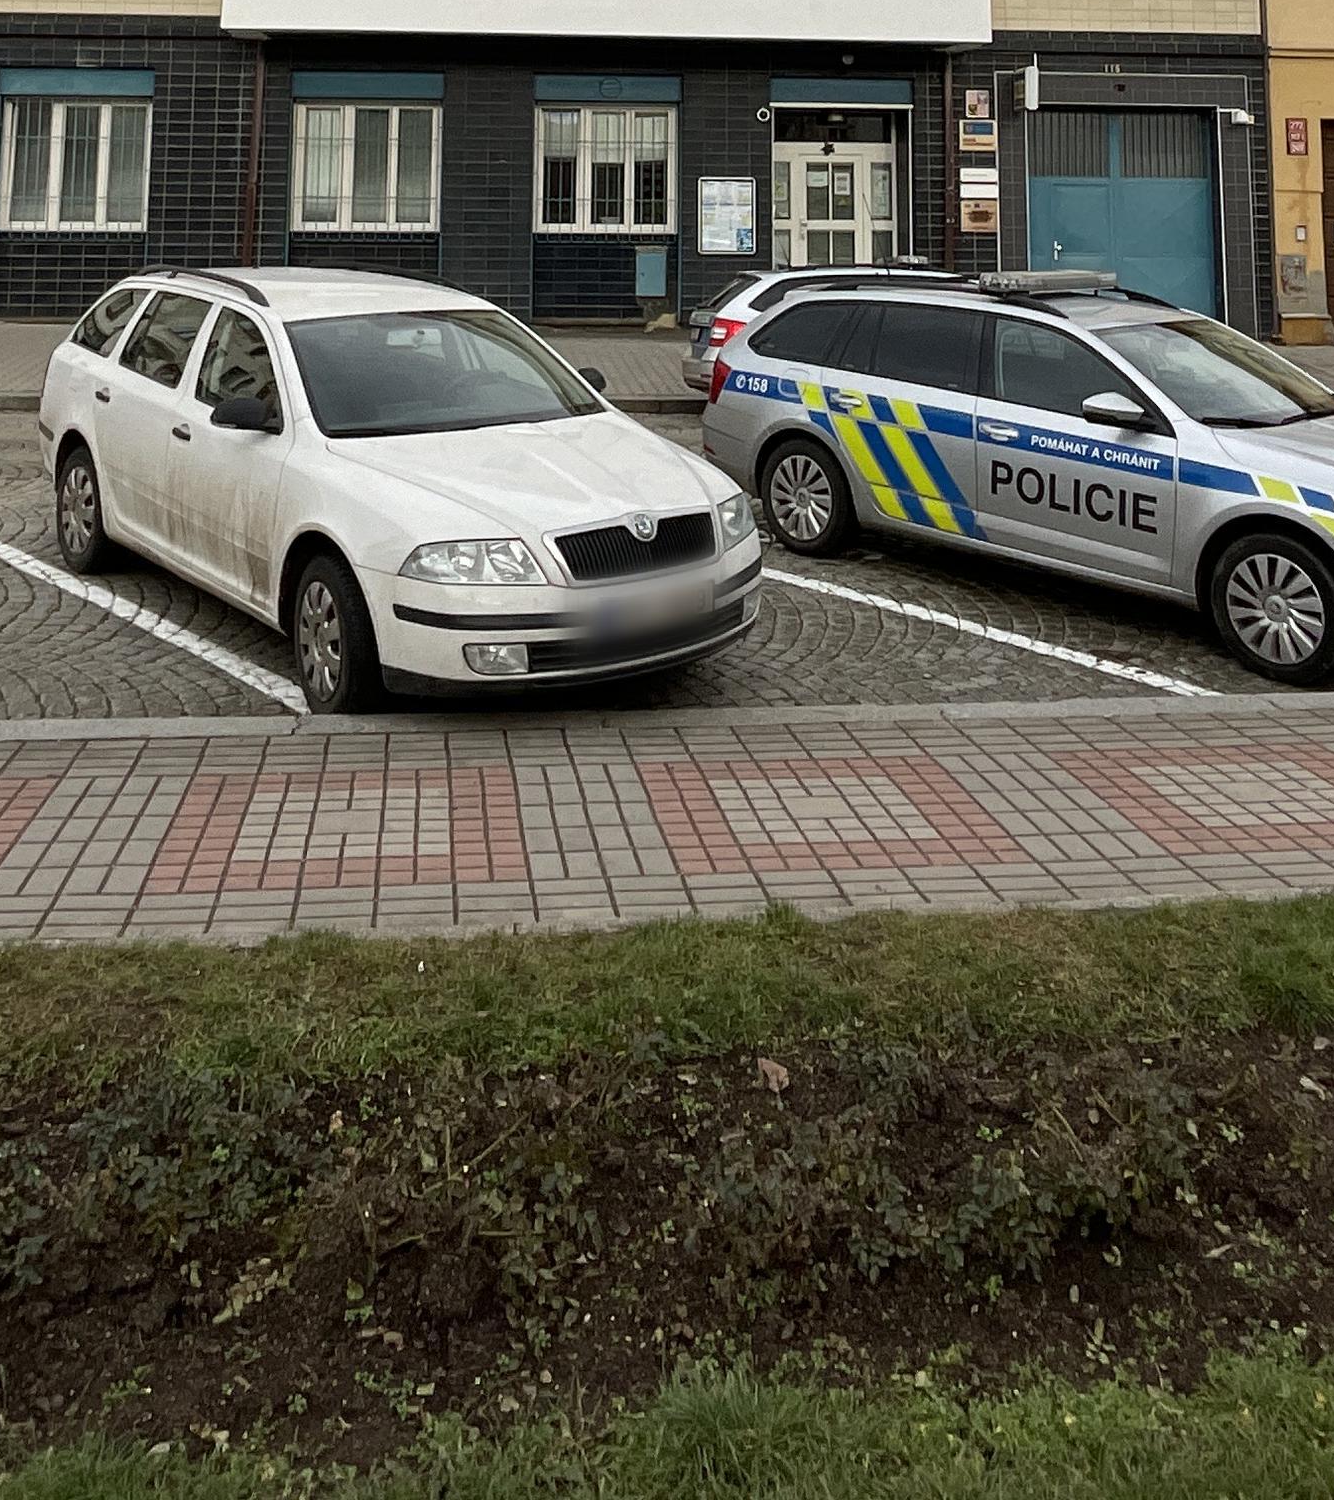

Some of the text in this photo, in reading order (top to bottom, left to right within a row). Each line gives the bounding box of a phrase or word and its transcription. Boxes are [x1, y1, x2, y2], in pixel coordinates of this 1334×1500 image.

[748, 377, 768, 393] 158
[1030, 434, 1161, 471] POMÁHAT A CHRÁNIT
[991, 460, 1158, 534] POLICIE
